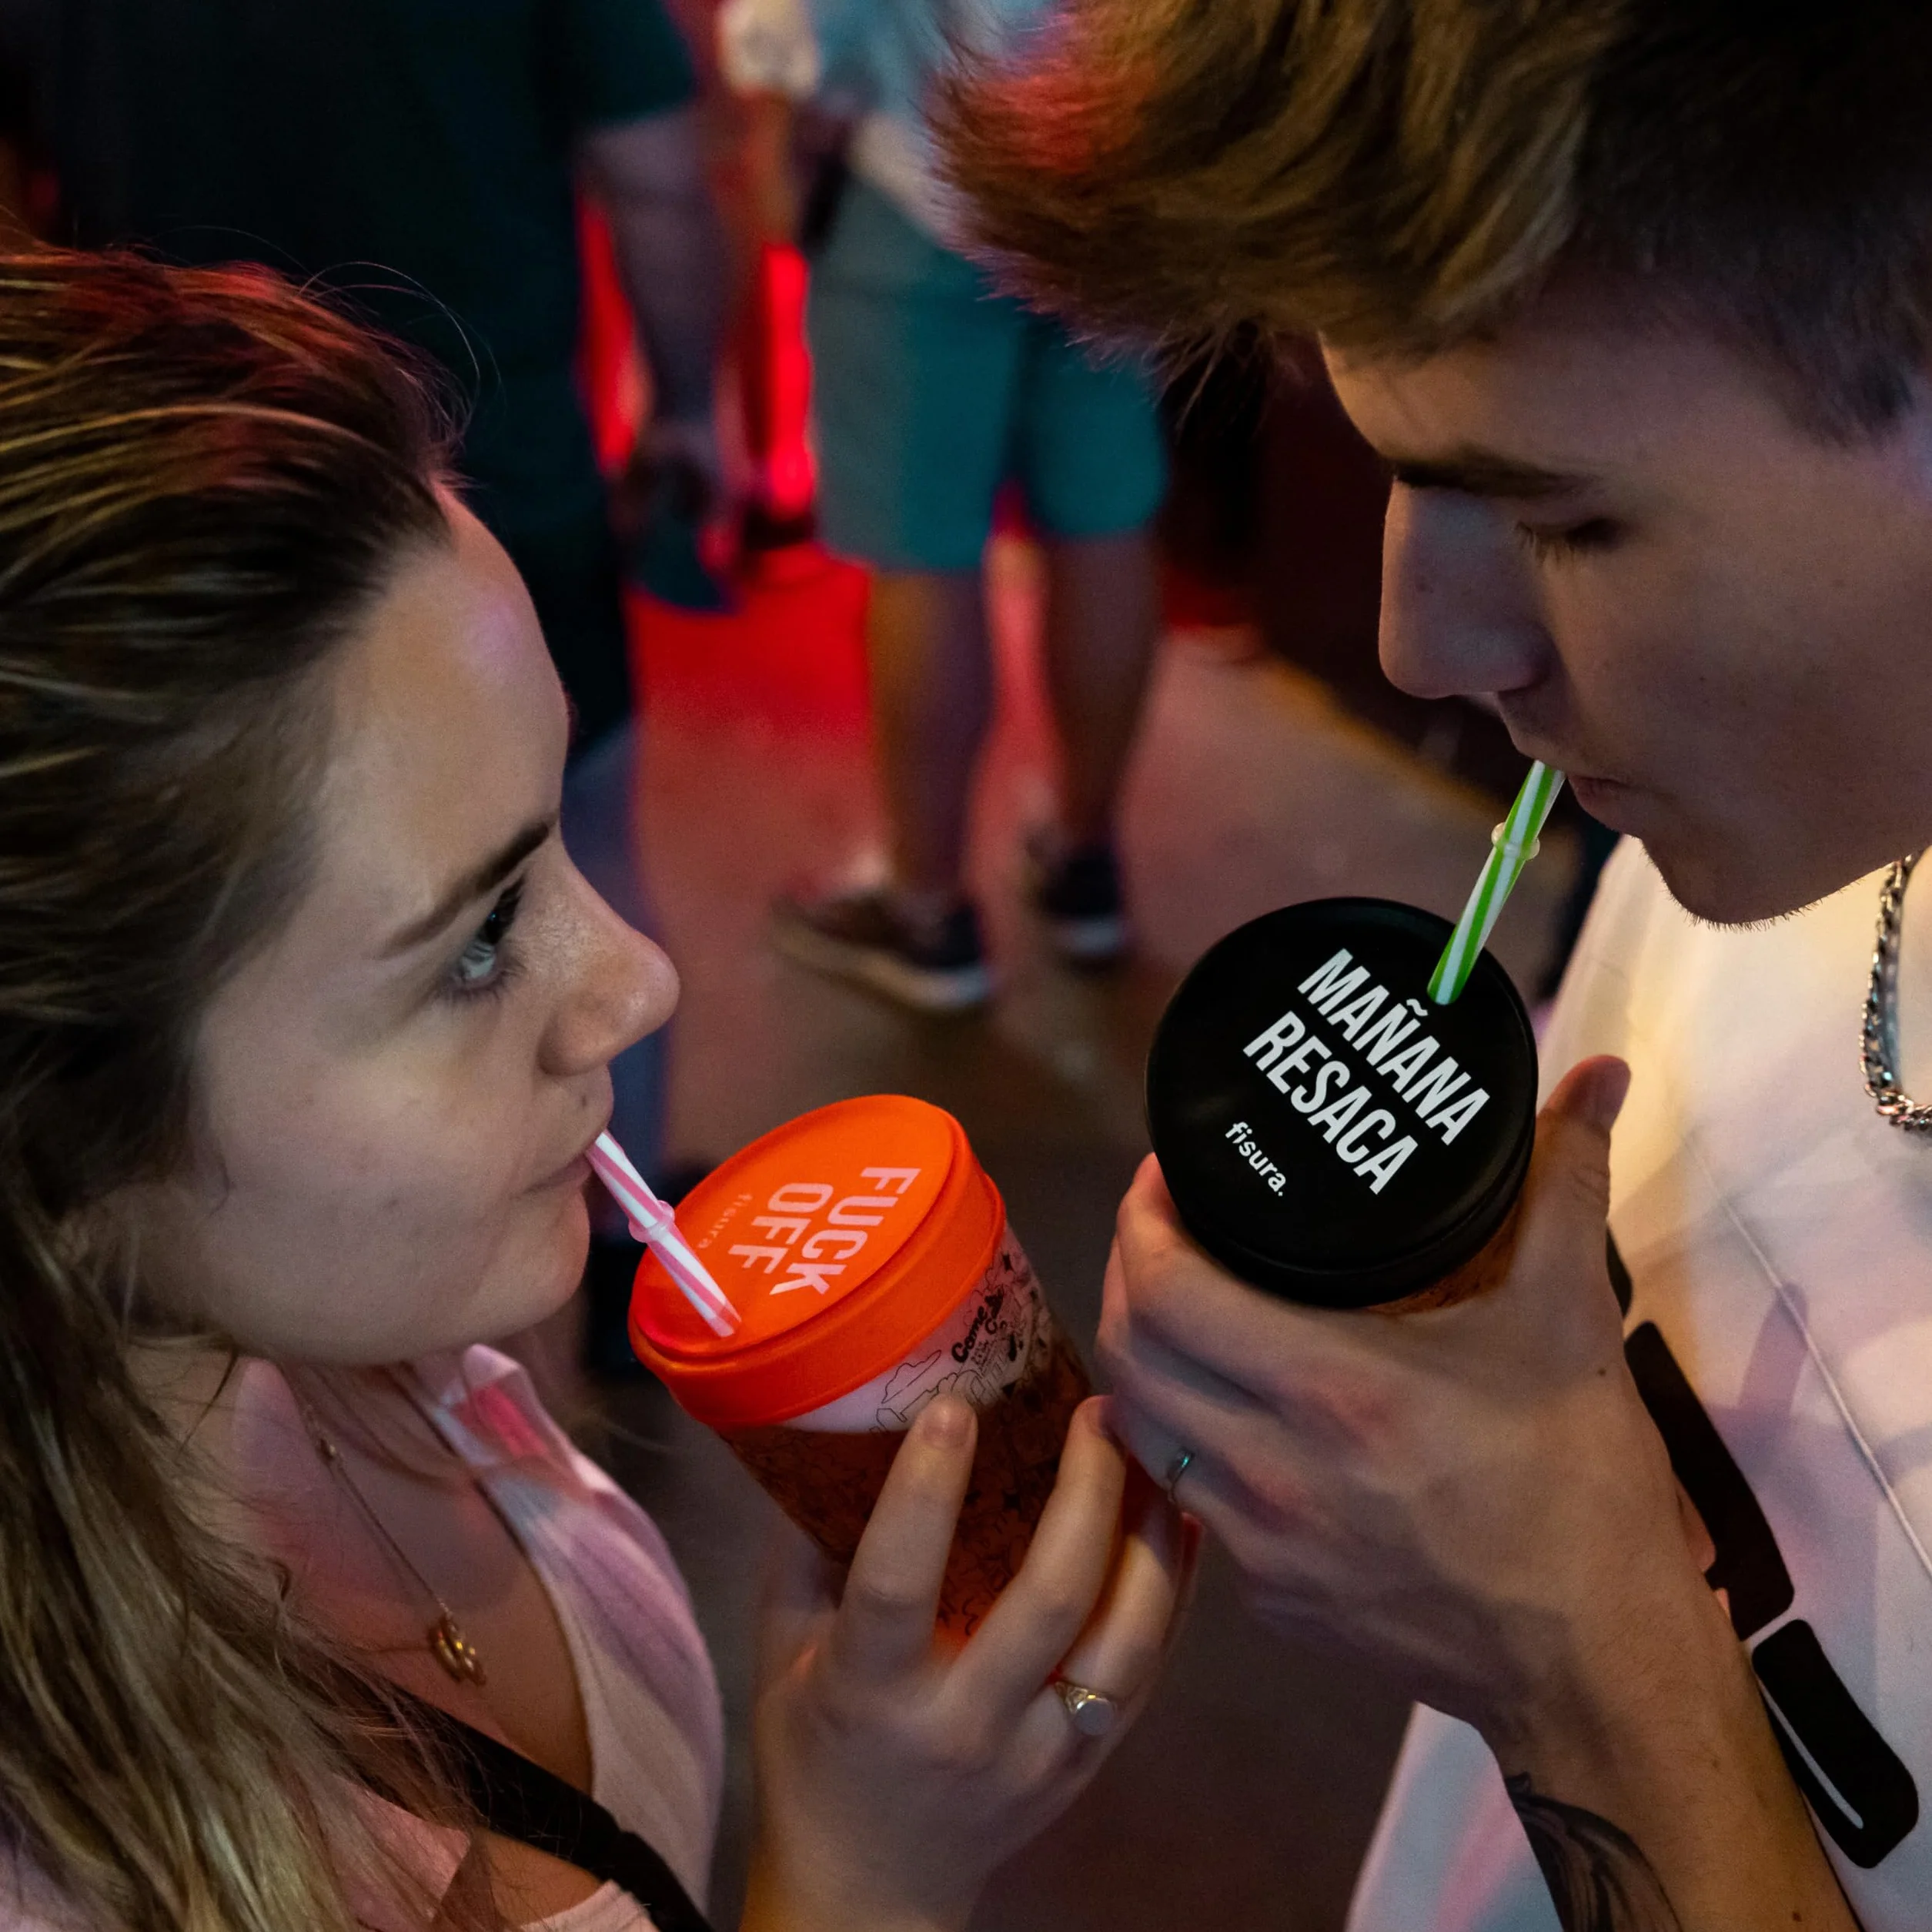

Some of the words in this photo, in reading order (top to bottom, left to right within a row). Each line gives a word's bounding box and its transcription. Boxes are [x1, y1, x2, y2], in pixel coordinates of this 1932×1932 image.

[1242, 1011, 1419, 1195] RESACA
[1297, 948, 1490, 1146] MAÑANA
[1225, 1121, 1286, 1197] fisura.
[728, 1182, 834, 1274] OFF
[770, 1166, 921, 1295] FUCK
